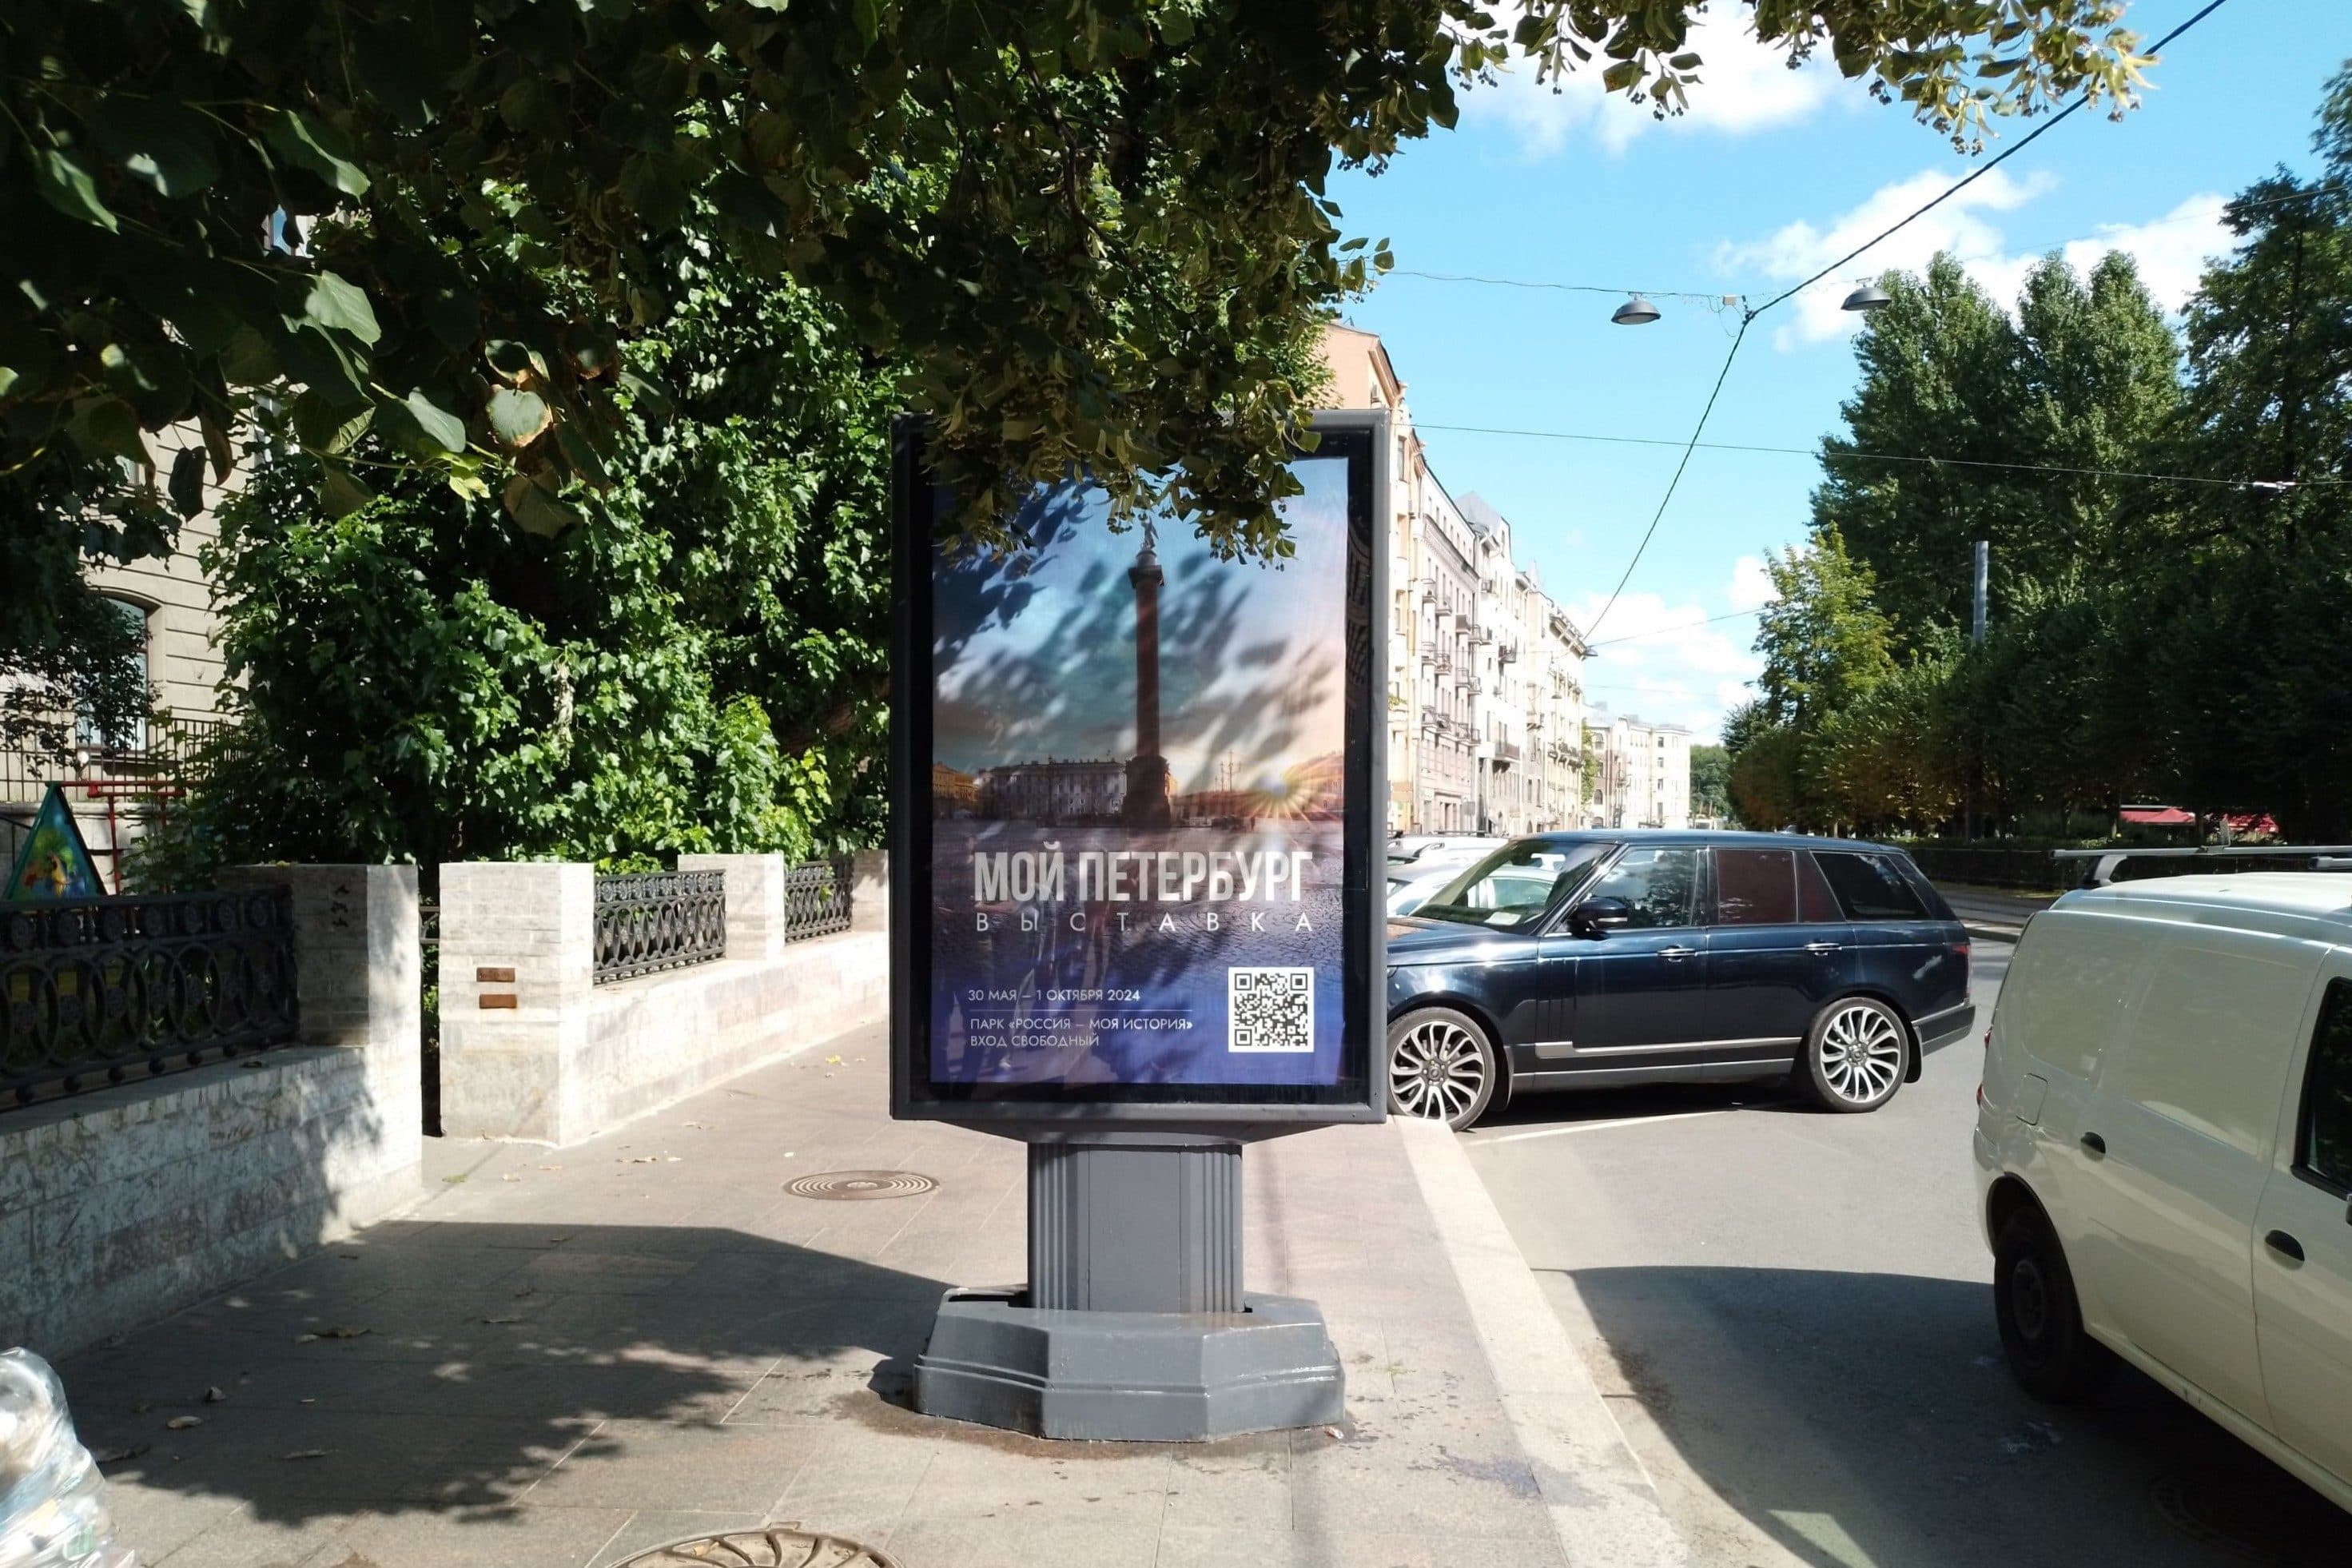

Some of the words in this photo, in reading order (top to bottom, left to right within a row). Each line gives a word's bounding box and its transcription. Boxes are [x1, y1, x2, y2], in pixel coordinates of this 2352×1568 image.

[974, 841, 1064, 901] МОЙ
[1079, 851, 1312, 901] ПЕТЕРБУРГ
[976, 912, 1312, 932] ВЫСТАВКА
[968, 989, 984, 1001] 30
[988, 989, 1017, 1001] МАЯ
[1037, 989, 1041, 1001] 1
[1046, 989, 1103, 1001] ОКТЯБРЯ
[1107, 989, 1140, 1001] 2024
[970, 1018, 1005, 1029] ПАРК
[1009, 1017, 1071, 1029] «РОССИЯ
[1089, 1018, 1119, 1029] МОЯ
[1123, 1017, 1192, 1029] ИСТОРИЯ»
[970, 1035, 1008, 1048] ВХОД
[1011, 1033, 1100, 1048] СВОБОДНЫЙ
